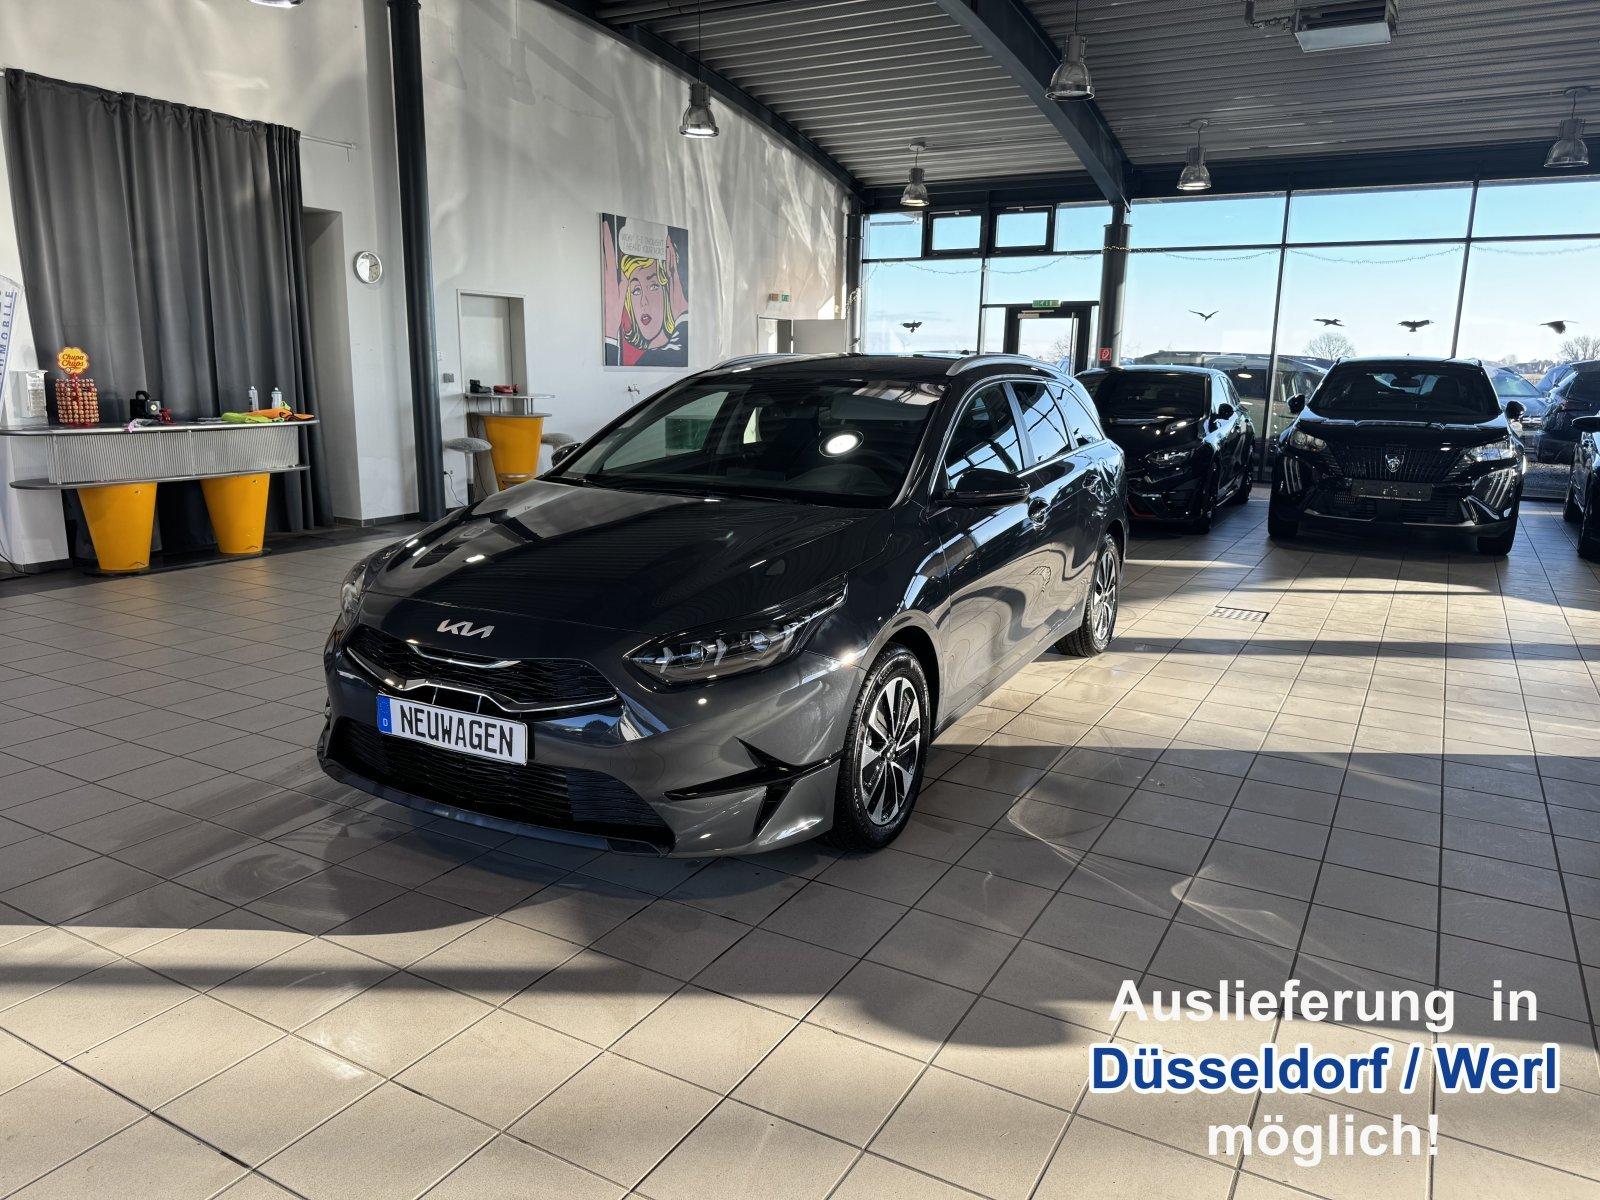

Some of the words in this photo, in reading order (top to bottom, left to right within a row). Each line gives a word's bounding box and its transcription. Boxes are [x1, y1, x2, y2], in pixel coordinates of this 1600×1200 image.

[62, 353, 85, 362] Chupa
[61, 359, 84, 368] Chups
[399, 704, 514, 758] NEUWAGEN
